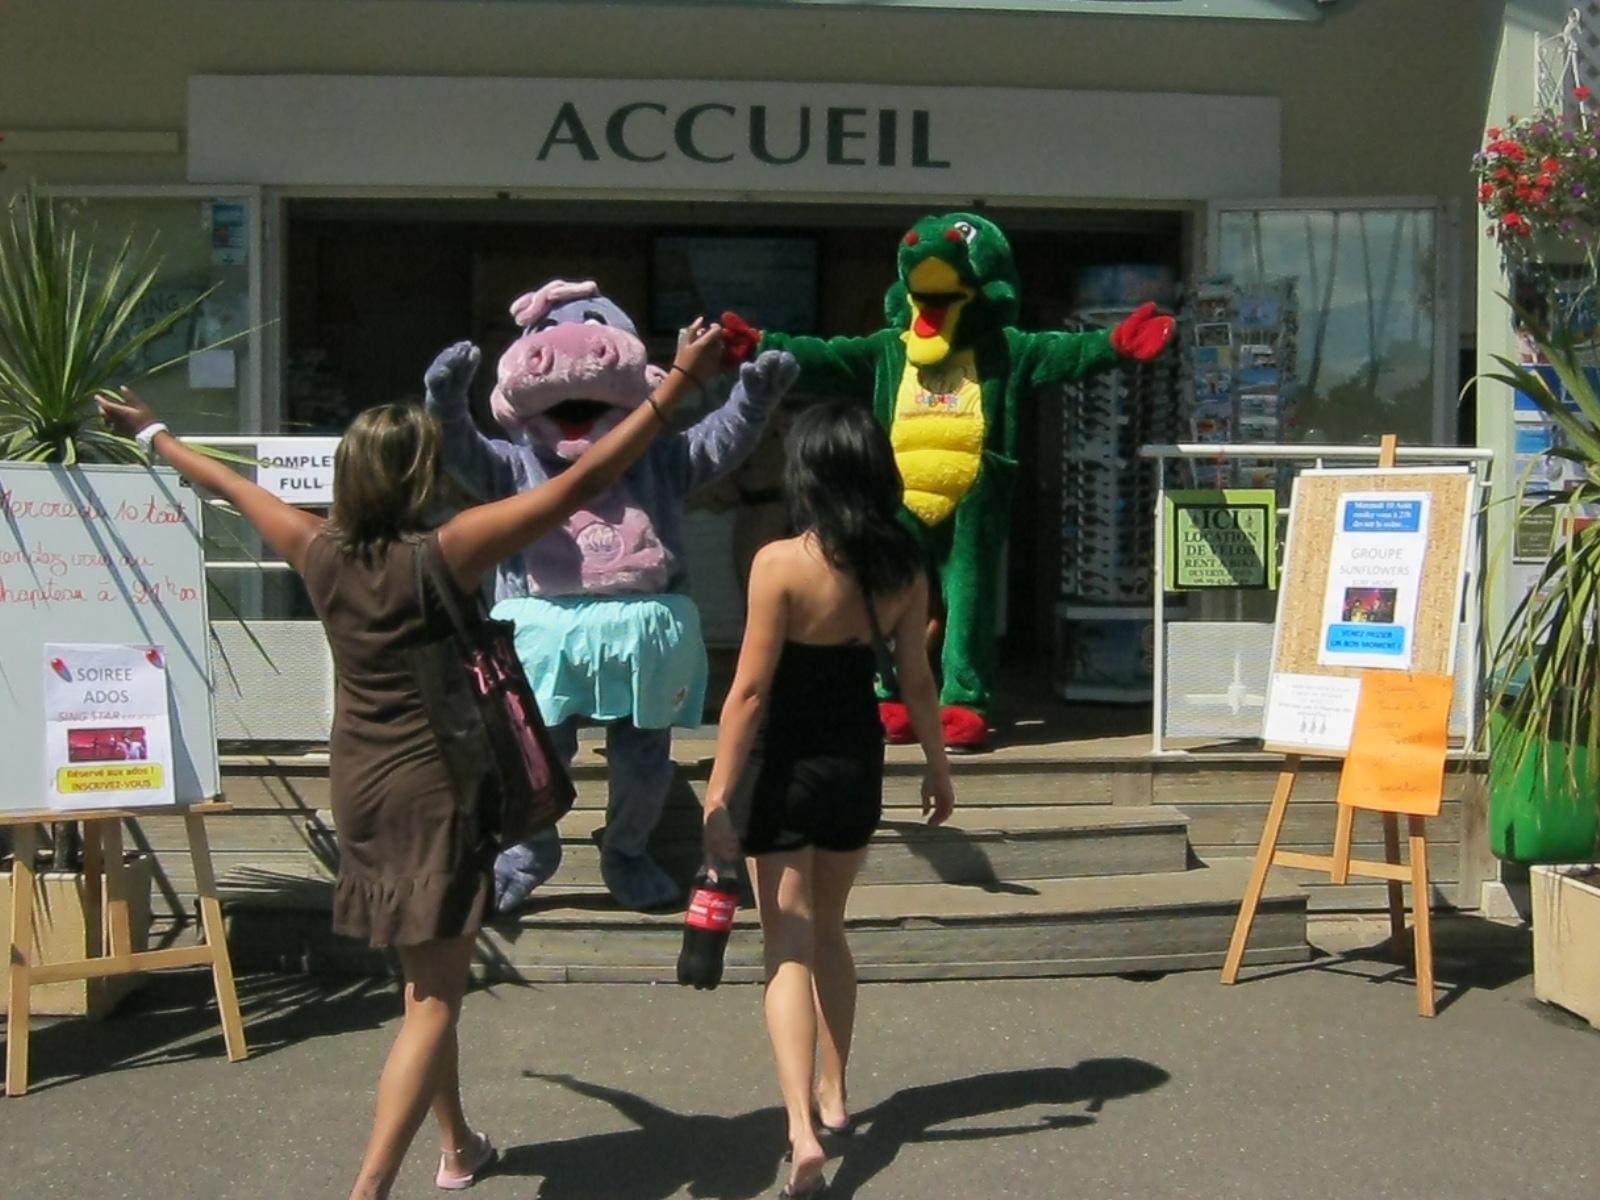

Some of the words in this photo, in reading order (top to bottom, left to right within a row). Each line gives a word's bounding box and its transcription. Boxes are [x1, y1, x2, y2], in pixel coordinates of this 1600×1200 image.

[535, 101, 951, 168] ACCUEIL
[261, 456, 334, 468] COMPLE
[280, 478, 323, 489] FULL
[1201, 510, 1240, 529] ICI
[1184, 531, 1258, 542] LOCATION
[1186, 544, 1207, 555] DE
[1351, 547, 1403, 560] GROUPE
[1184, 559, 1217, 568] RENT
[1340, 564, 1410, 576] SUNFLOWERS
[0, 575, 88, 609] hapiteau
[77, 668, 133, 681] SOIREE
[83, 690, 130, 703] ADOS
